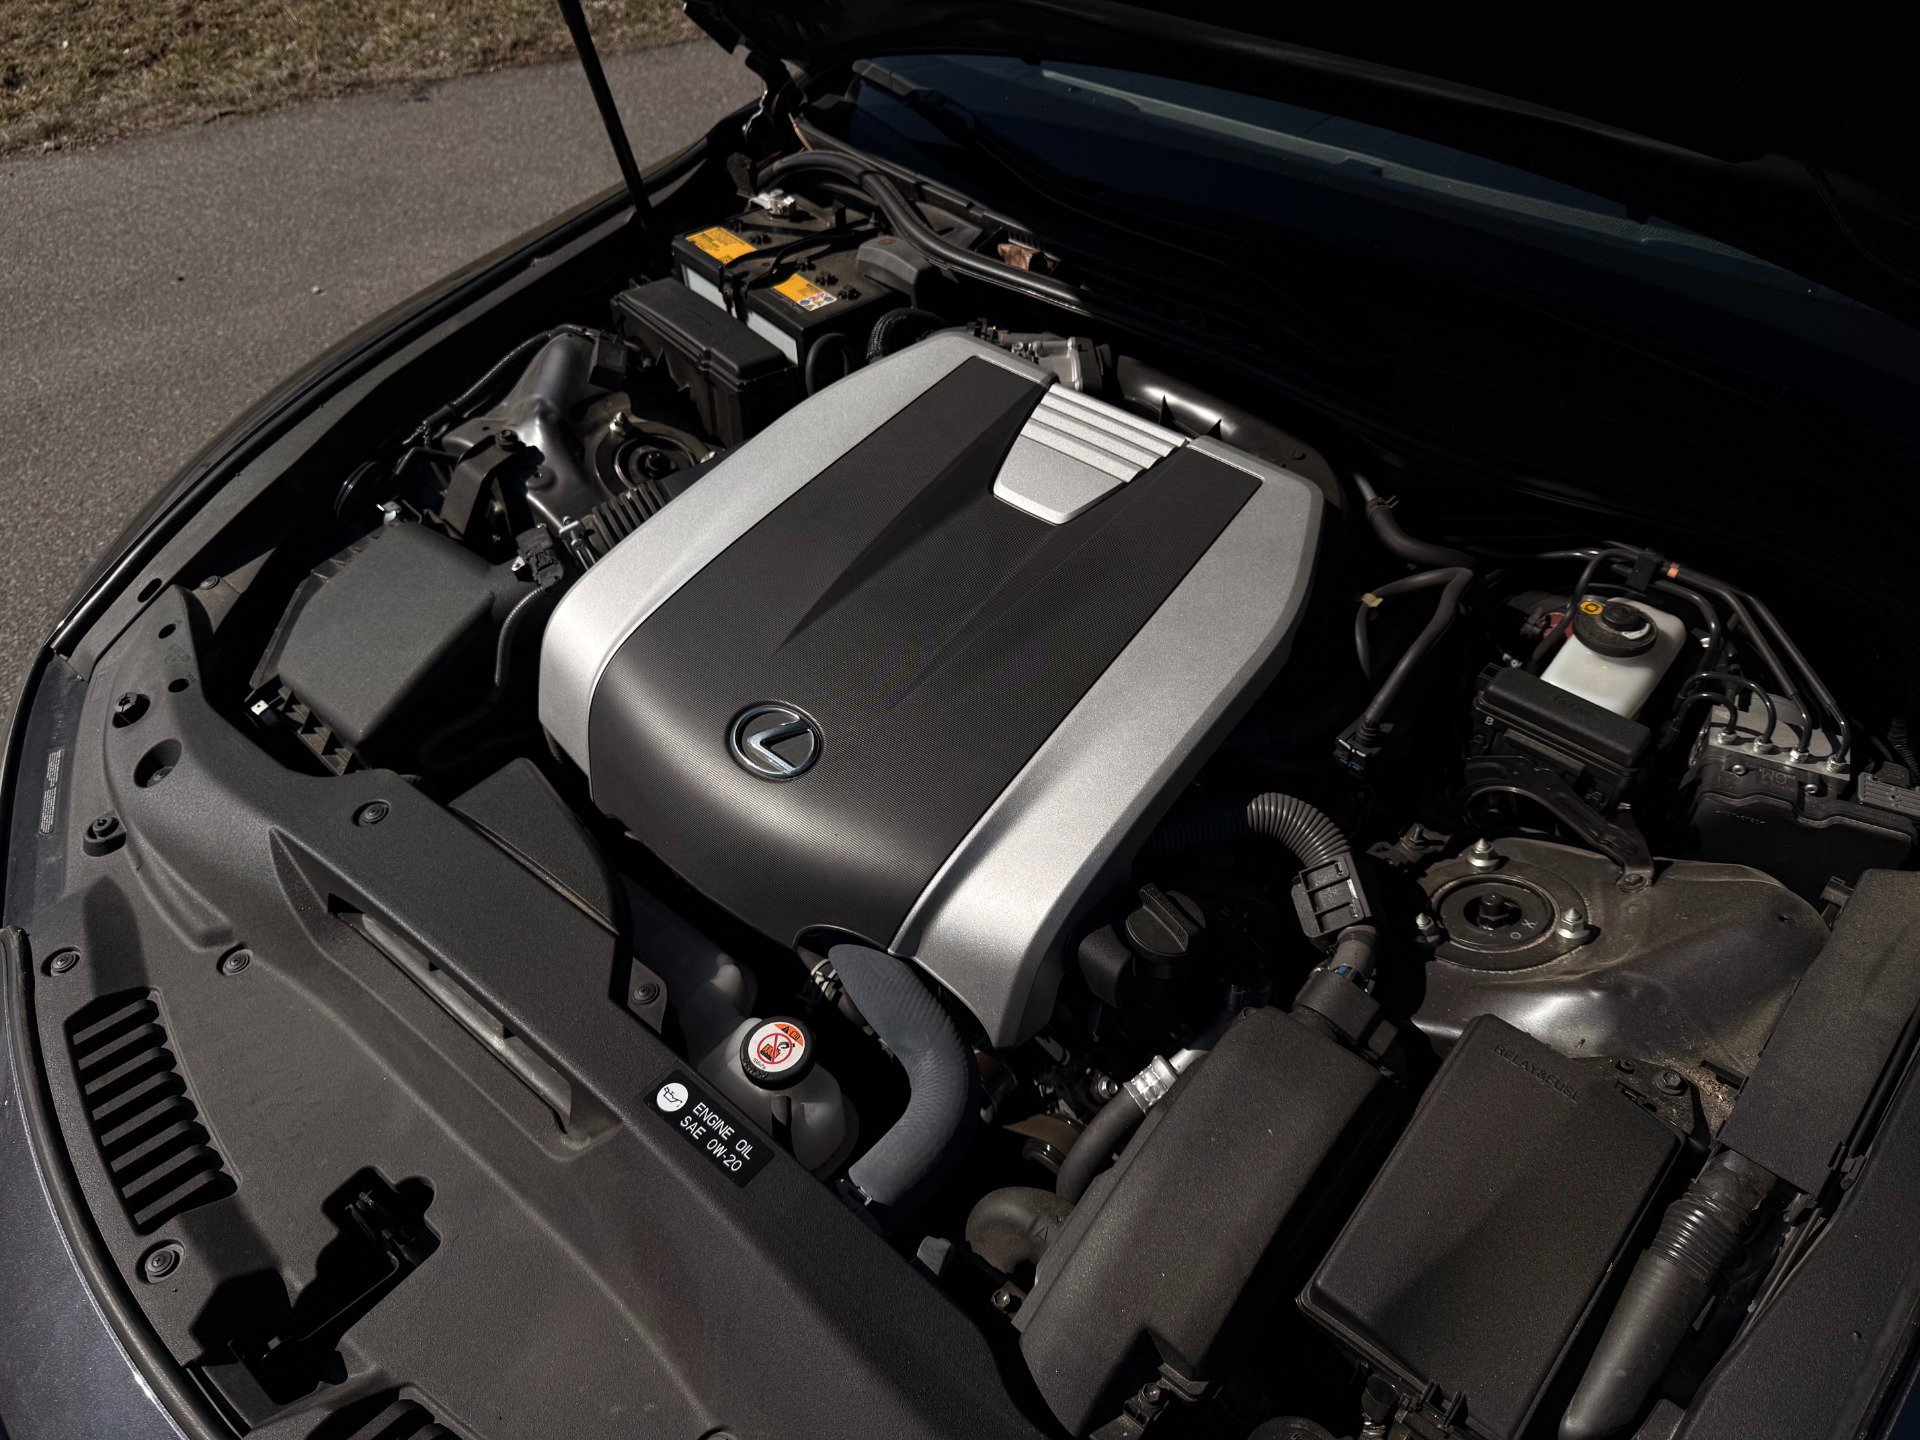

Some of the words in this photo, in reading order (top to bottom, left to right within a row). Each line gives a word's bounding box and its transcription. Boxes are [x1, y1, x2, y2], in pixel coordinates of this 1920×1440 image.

[680, 1115, 706, 1140] SAE
[706, 1138, 743, 1172] 0W-20
[692, 1101, 736, 1141] ENGINE
[735, 1139, 753, 1161] OIL
